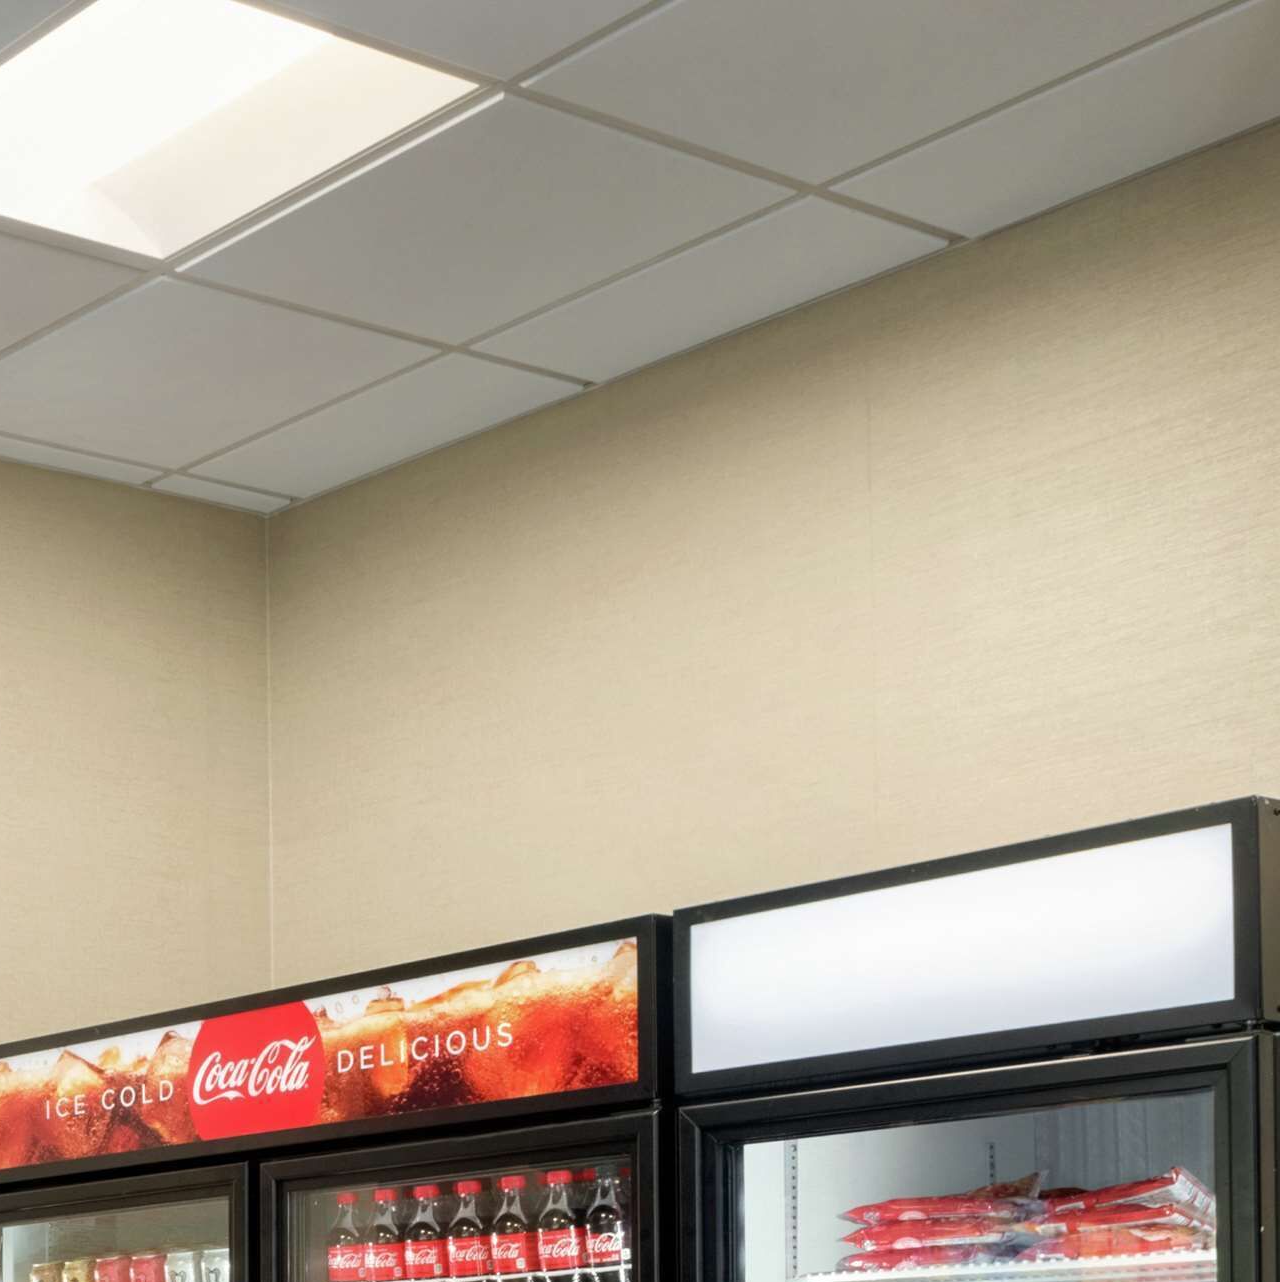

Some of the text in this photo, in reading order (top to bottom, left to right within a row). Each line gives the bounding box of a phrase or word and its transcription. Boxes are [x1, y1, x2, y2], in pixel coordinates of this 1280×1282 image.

[192, 1034, 316, 1105] Coca-Cola
[337, 1022, 514, 1074] DELICIOUS
[45, 1080, 174, 1120] ICE COLD
